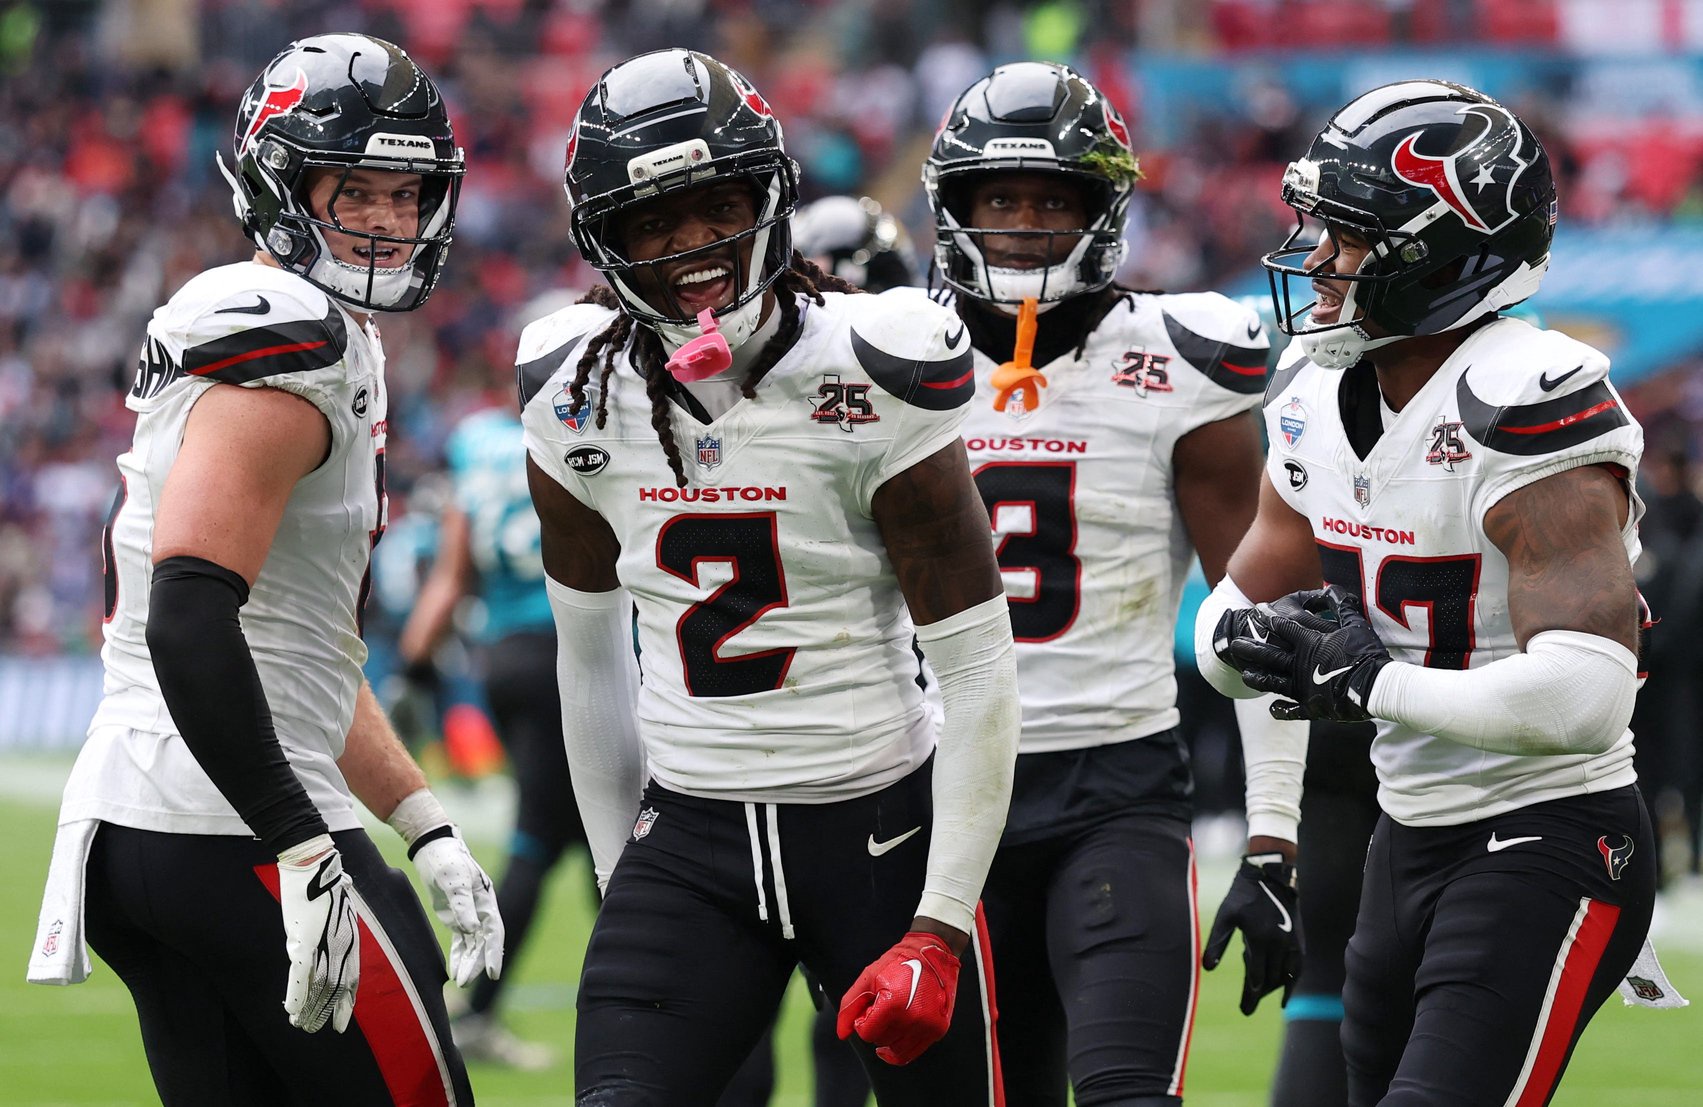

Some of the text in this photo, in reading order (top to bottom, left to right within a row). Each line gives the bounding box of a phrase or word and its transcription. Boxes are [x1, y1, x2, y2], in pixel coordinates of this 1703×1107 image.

[378, 138, 431, 149] TEXANS
[652, 155, 684, 167] TEXANS
[1122, 351, 1171, 388] 25
[817, 382, 873, 422] 25
[1281, 418, 1303, 429] LONDON
[967, 439, 1087, 453] OUSTON
[1432, 421, 1464, 463] 25
[700, 450, 718, 463] NFL
[639, 486, 787, 503] HOUSTON
[1322, 516, 1415, 545] HOUSTON
[971, 461, 1081, 643] 3
[656, 511, 797, 697] 2
